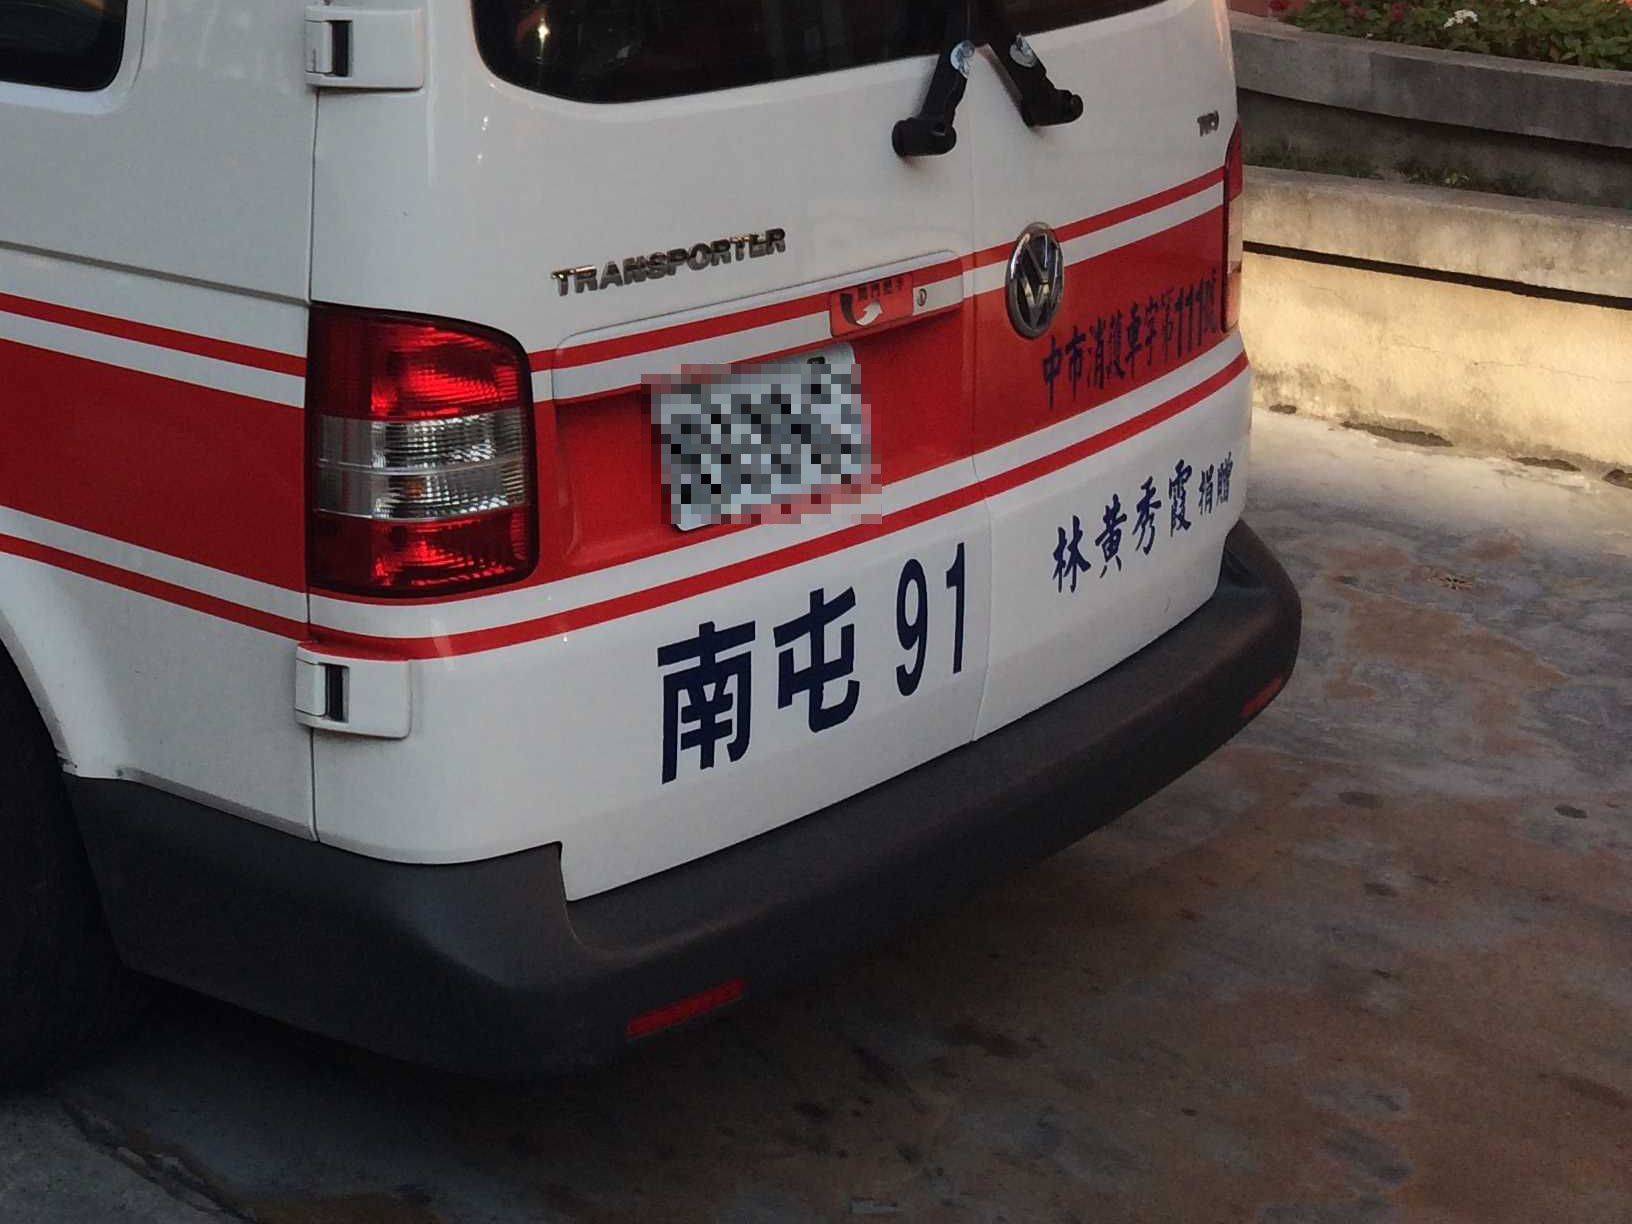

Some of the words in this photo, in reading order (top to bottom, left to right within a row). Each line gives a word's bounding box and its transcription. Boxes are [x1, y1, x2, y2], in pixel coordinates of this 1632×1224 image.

[551, 227, 786, 297] TRANSPORTER
[1052, 458, 1194, 594] 林黃秀霞
[1198, 450, 1234, 516] 捐贈
[656, 585, 861, 786] 南屯
[895, 541, 966, 697] 91
